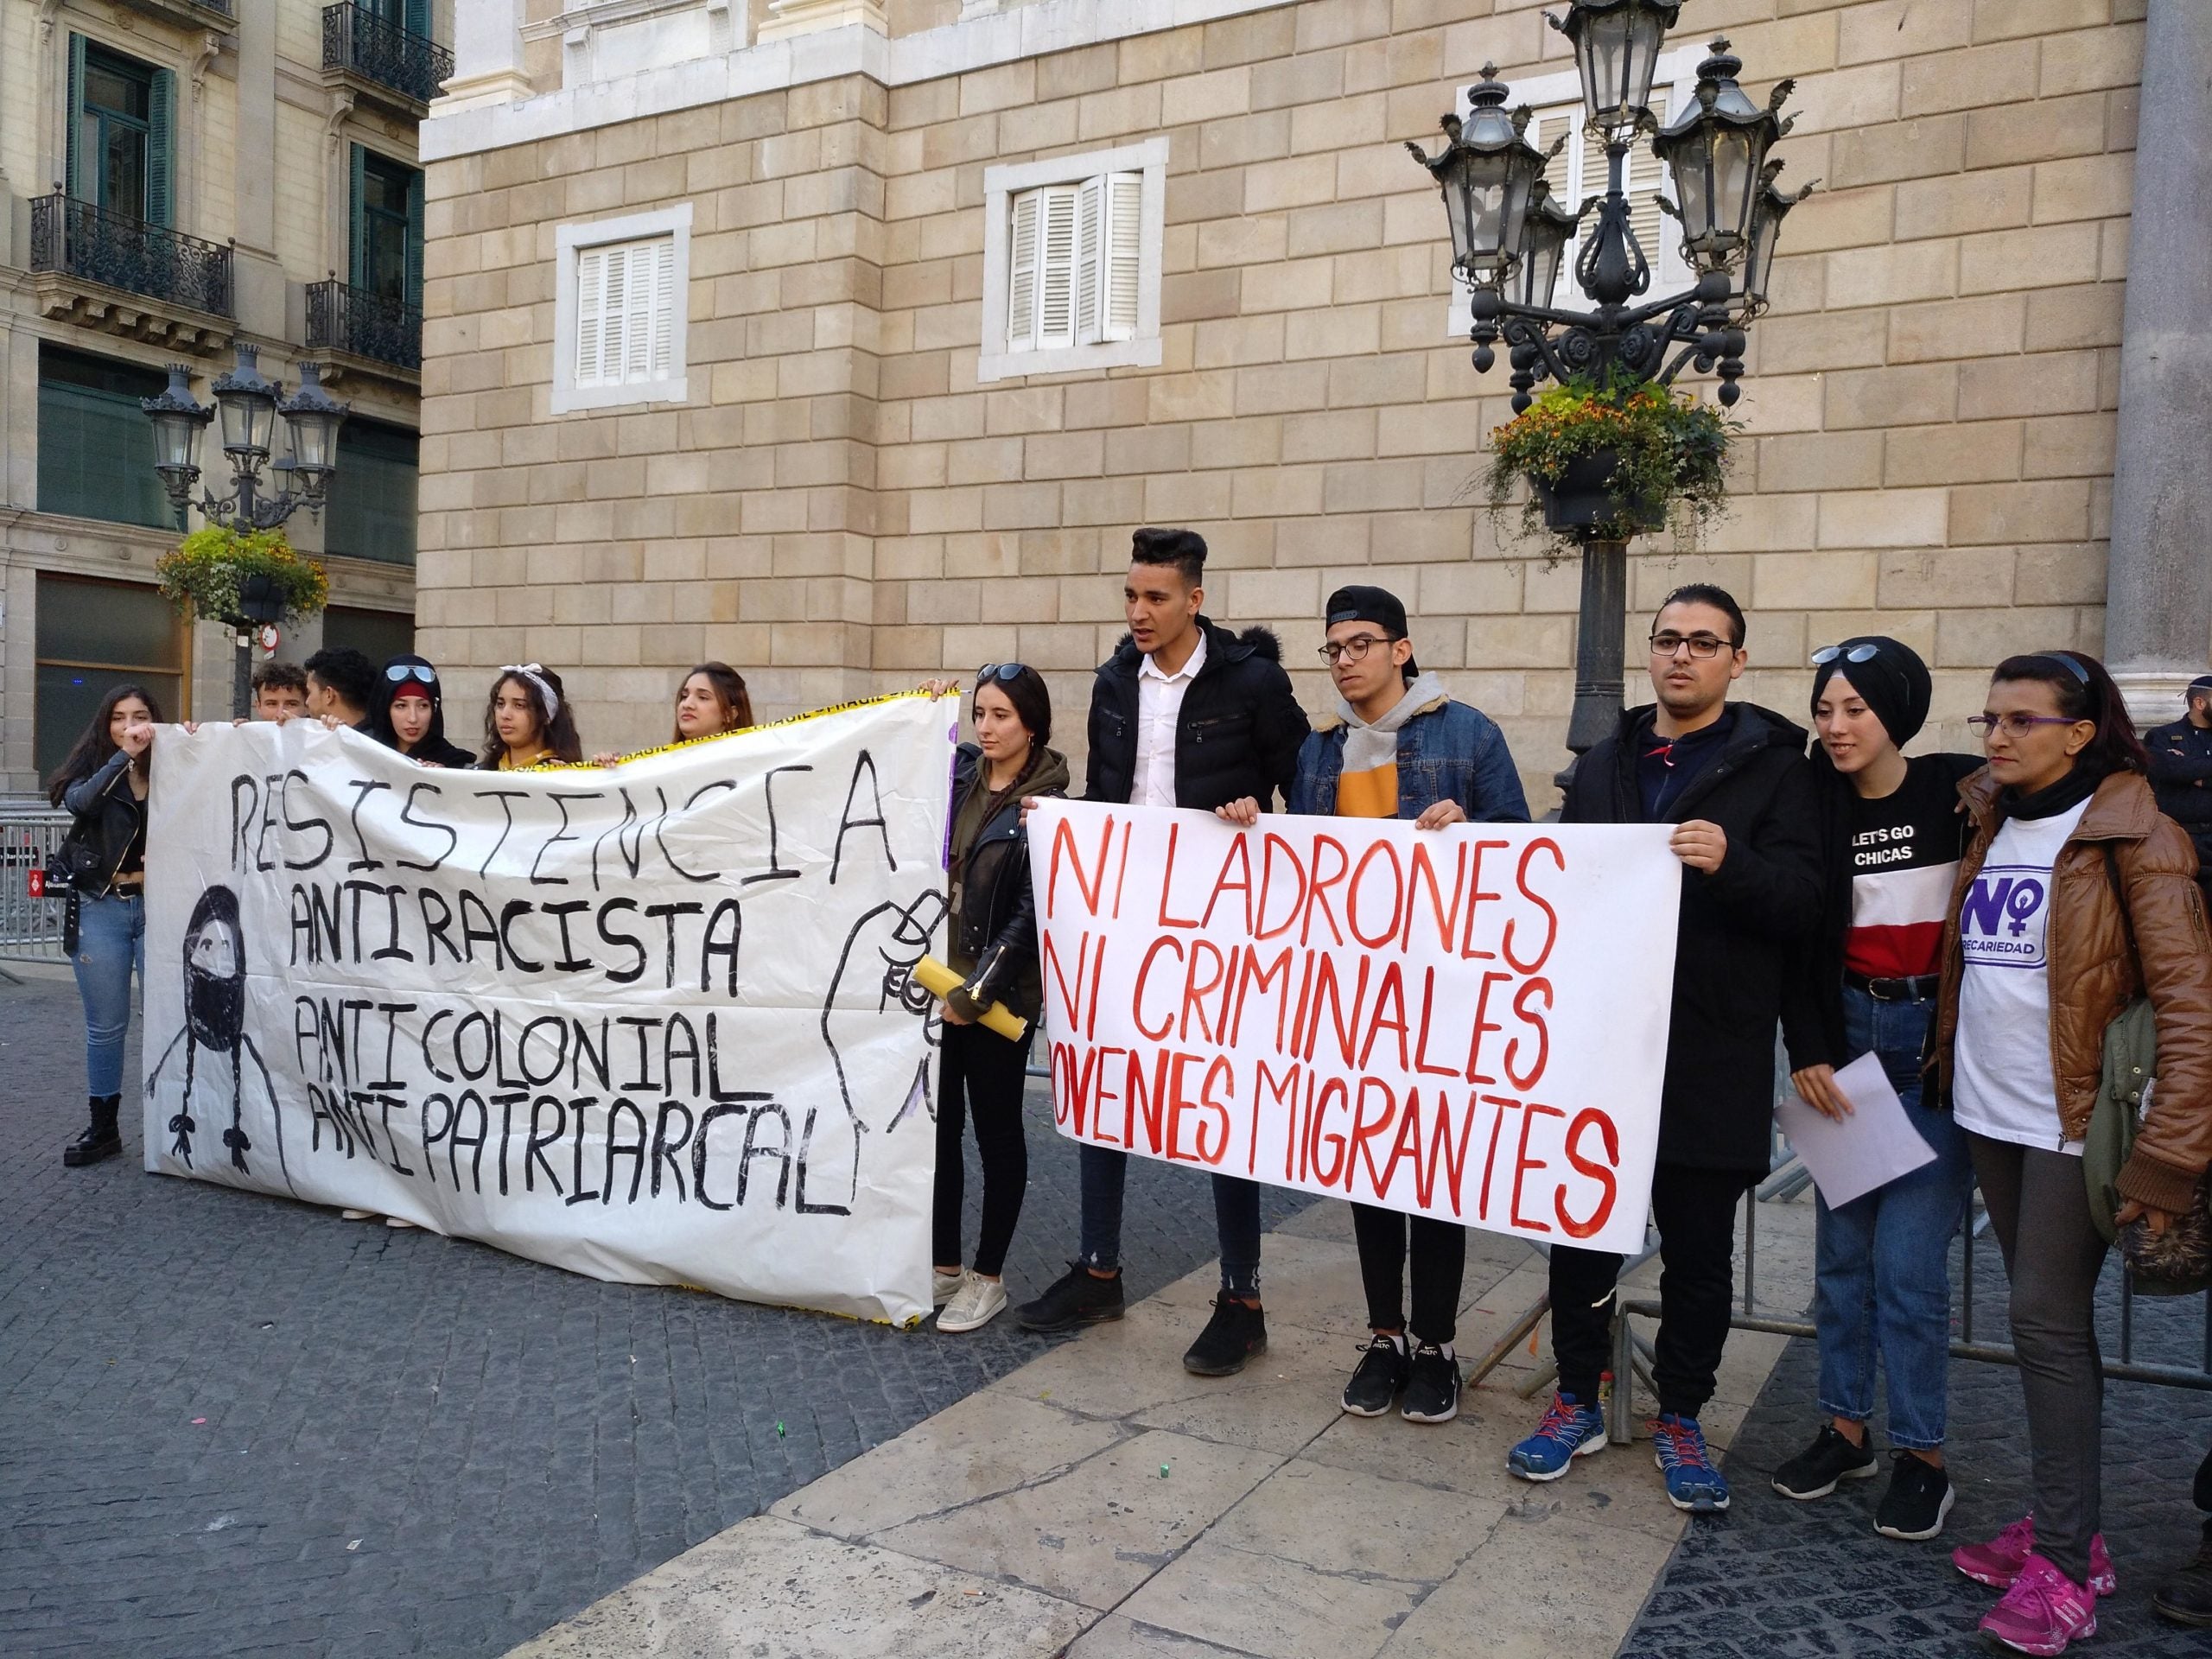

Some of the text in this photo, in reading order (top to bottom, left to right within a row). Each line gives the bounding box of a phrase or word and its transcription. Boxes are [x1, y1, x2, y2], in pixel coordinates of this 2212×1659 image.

[231, 748, 897, 891] RESISTENCIA
[1852, 825, 1914, 847] LET'S GO
[1854, 846, 1912, 866] CHICAS
[290, 880, 742, 997] ANTIRACISTA
[1047, 813, 1566, 976] NI LADRONES
[1962, 939, 2036, 955] RECARIEDAD
[295, 995, 774, 1102] ANTICOLONIAL
[1044, 929, 1554, 1091] NI CRIMINALES
[1249, 1059, 1620, 1239] MIGRANTES
